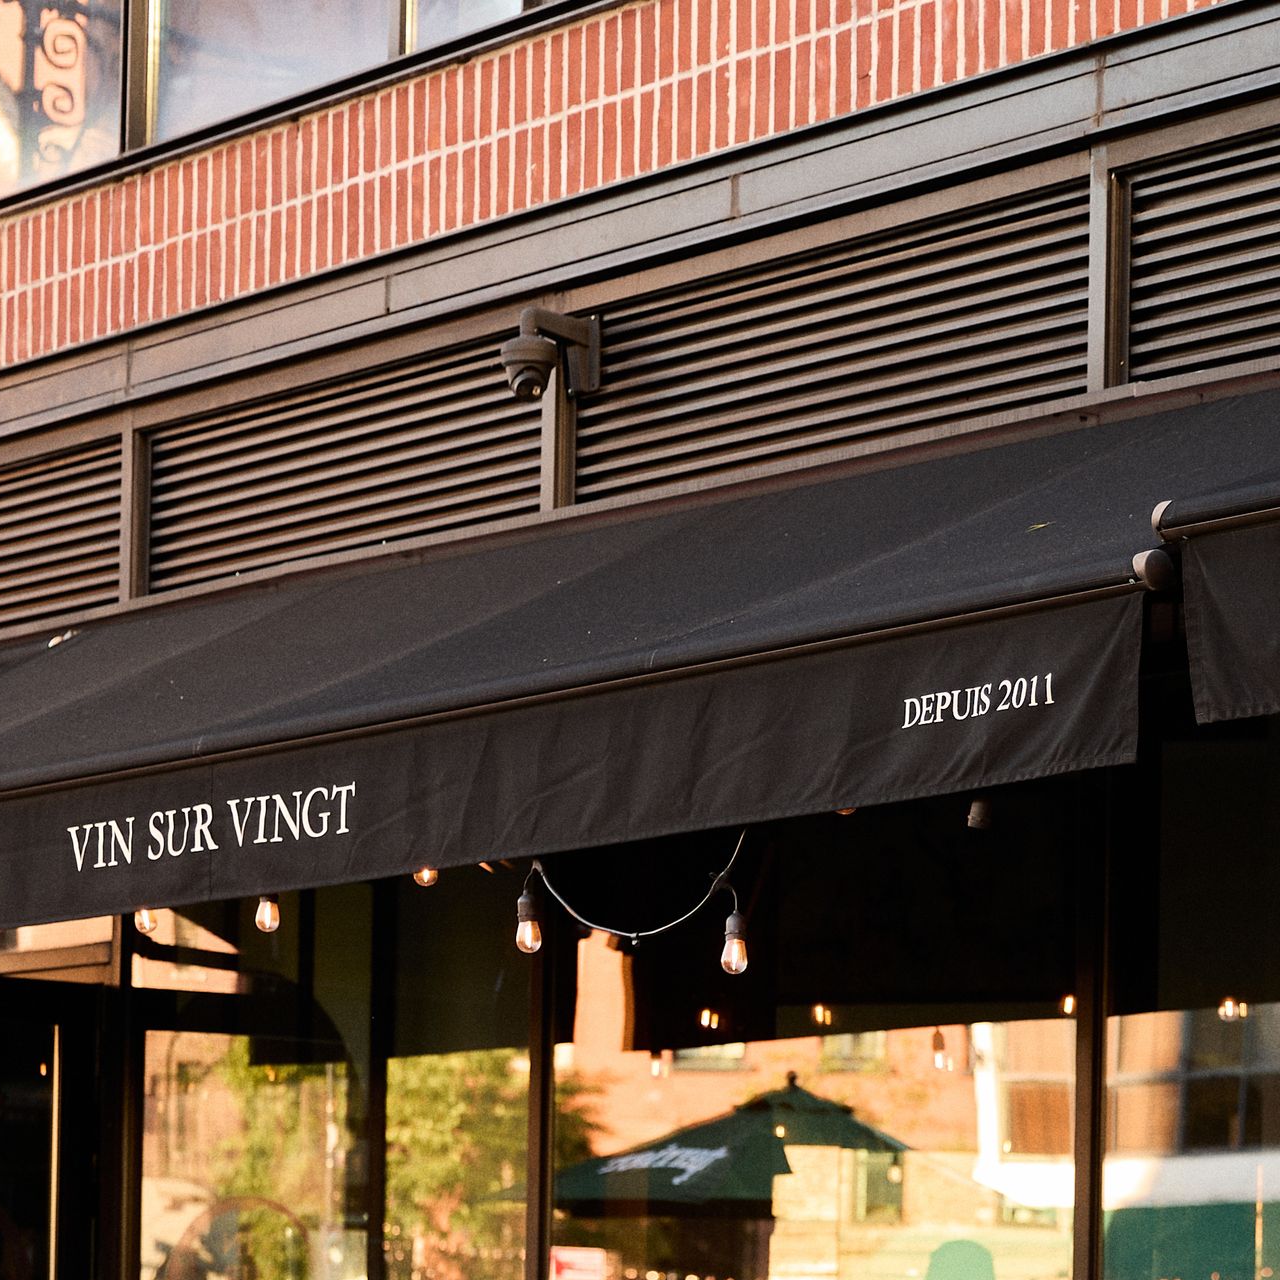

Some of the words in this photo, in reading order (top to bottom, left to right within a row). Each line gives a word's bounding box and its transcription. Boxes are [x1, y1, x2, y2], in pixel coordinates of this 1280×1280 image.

[901, 682, 993, 729] DEPUIS
[996, 672, 1056, 712] 2011
[66, 816, 135, 872] VIN
[147, 803, 219, 861] SUR
[226, 781, 356, 848] VINGT
